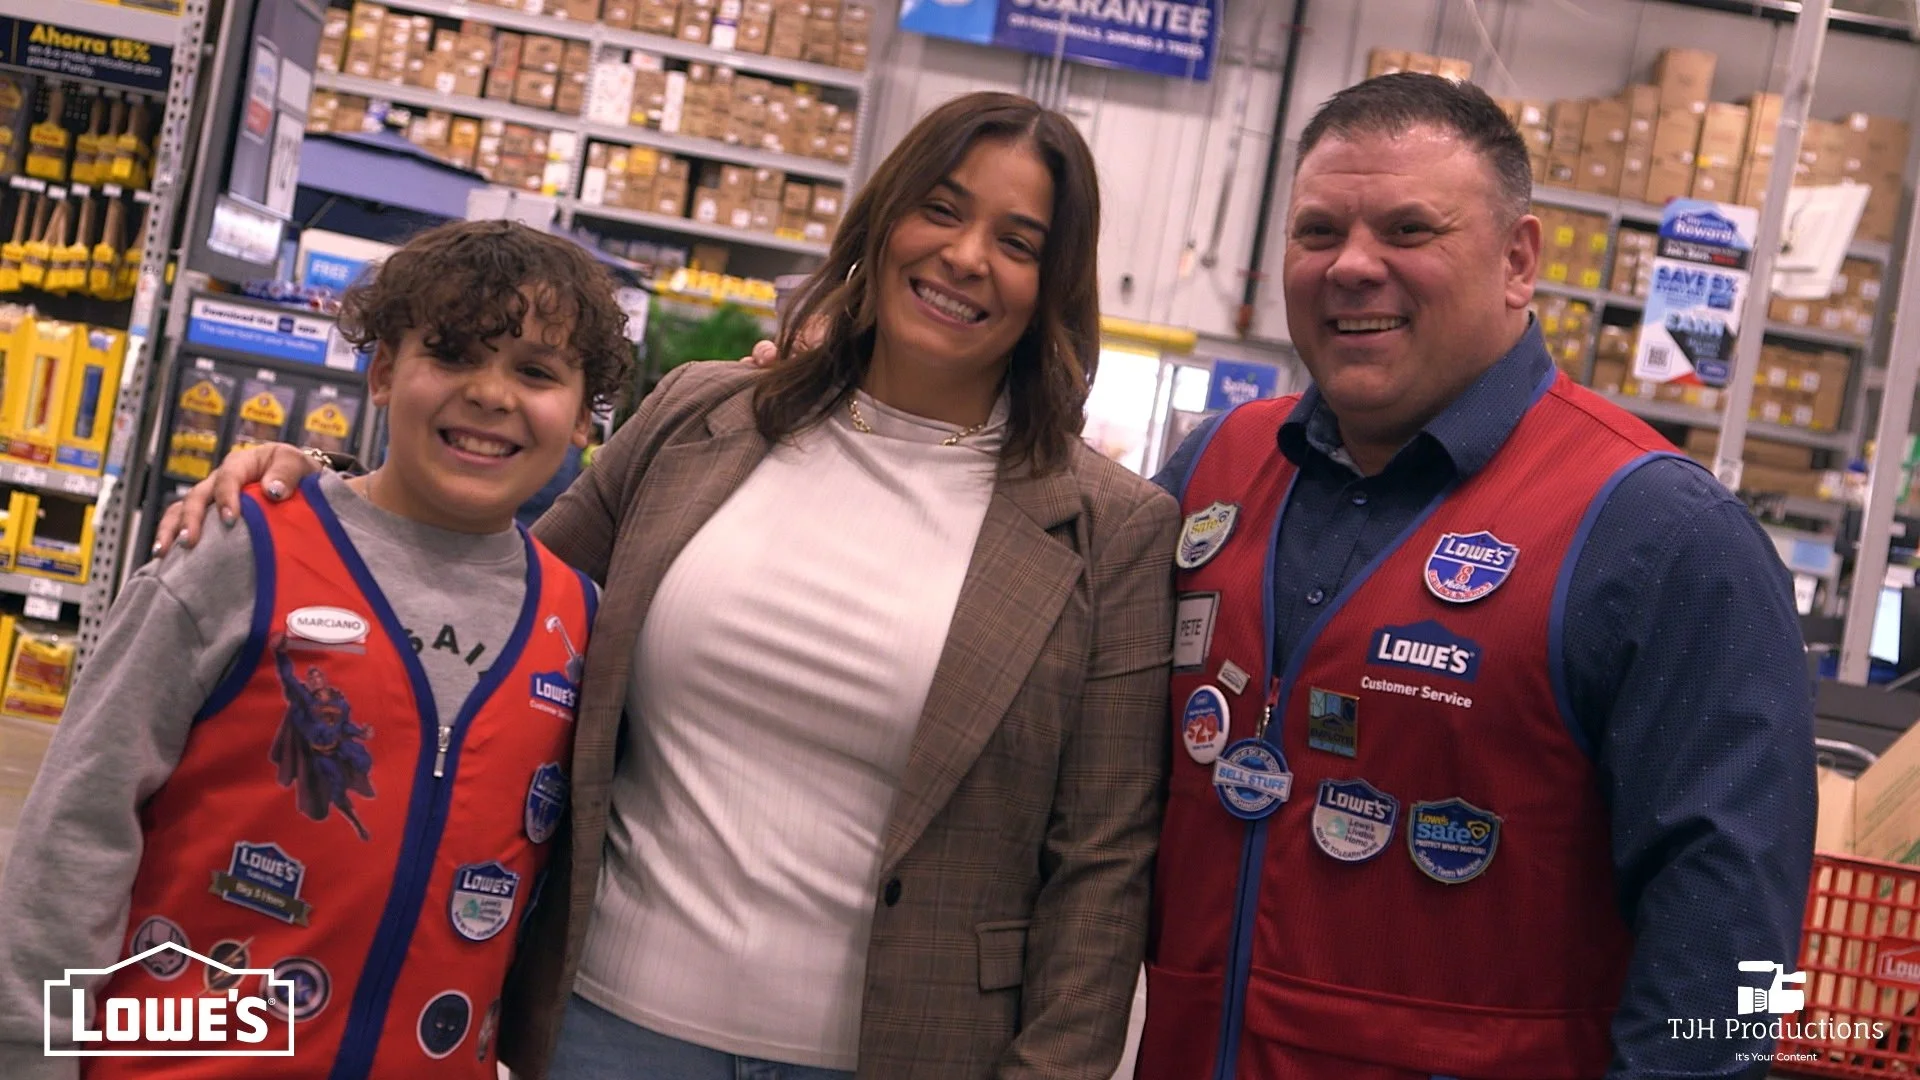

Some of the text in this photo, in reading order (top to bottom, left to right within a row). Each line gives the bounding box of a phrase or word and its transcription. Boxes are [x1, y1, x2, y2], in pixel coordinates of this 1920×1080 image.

[29, 23, 151, 63] Ahorra 15%
[311, 260, 349, 281] FREE
[1657, 265, 1707, 286] SAVE
[1443, 538, 1507, 566] LOWE'S
[296, 616, 362, 631] MARCIANO
[1181, 618, 1203, 637] PETE
[1377, 633, 1470, 674] LOWE'S
[535, 677, 576, 707] LOWE'S
[1361, 675, 1473, 708] Customer Service
[1187, 713, 1220, 744] $29
[1218, 767, 1287, 790] SELL STUFF
[1326, 786, 1387, 820] LOWE'S
[1344, 834, 1369, 848] Home
[1416, 820, 1472, 845] safe
[240, 847, 297, 882] LOWE'S
[462, 870, 512, 895] LOWE'S
